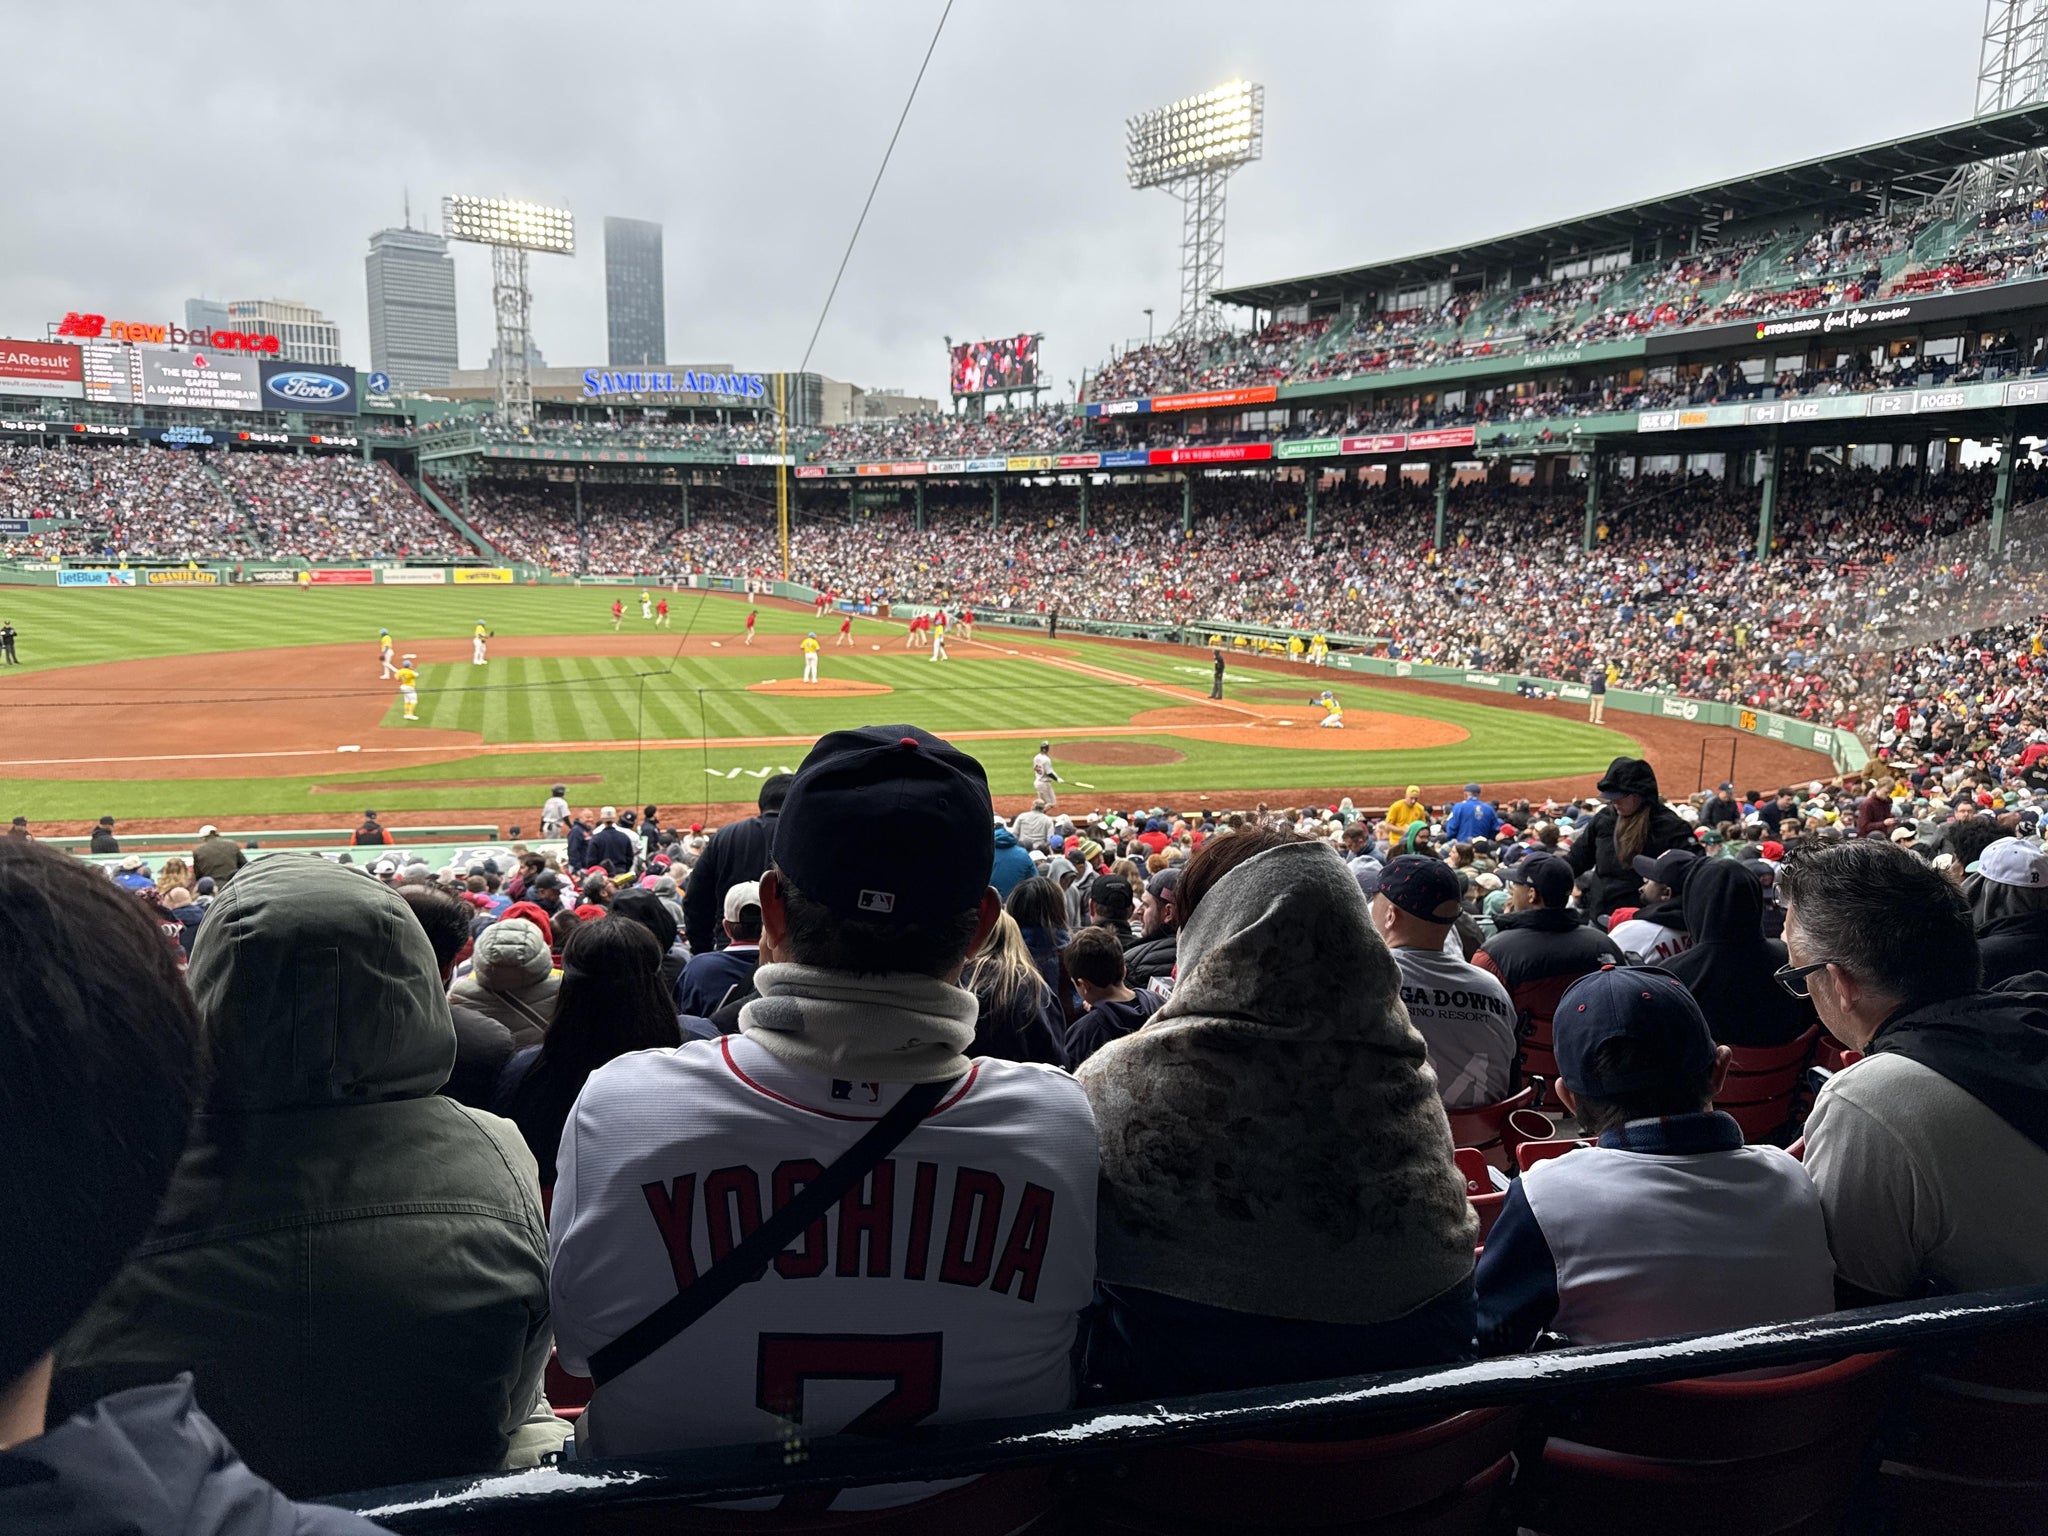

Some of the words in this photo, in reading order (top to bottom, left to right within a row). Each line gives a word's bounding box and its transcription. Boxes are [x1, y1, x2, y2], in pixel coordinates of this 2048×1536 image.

[1849, 309, 1869, 328] the
[110, 320, 166, 344] new
[169, 322, 280, 354] balance
[162, 367, 180, 377] THE
[182, 369, 199, 378] RED
[201, 370, 218, 380] SOX
[147, 385, 156, 394] A
[157, 385, 187, 395] HAPPY
[283, 376, 334, 398] Ford
[583, 368, 679, 397] SAMUEL
[680, 368, 764, 398] ADAMS
[2017, 384, 2039, 400] 0-1
[168, 396, 186, 406] AND
[188, 397, 213, 407] MANY
[1880, 398, 1902, 412] 1-2
[1920, 393, 1965, 408] ROGERS
[1756, 407, 1775, 420] 0-1
[1, 421, 17, 430] Tap
[17, 421, 24, 430] &
[25, 423, 37, 431] go
[1641, 415, 1659, 428] DUE
[1660, 414, 1673, 427] UP
[86, 424, 101, 434] Tap
[101, 425, 108, 433] &
[109, 427, 120, 435] go
[160, 433, 214, 444] ORCHARD
[63, 572, 101, 584] jetBlue
[195, 571, 217, 583] CITY
[1438, 1009, 1490, 1023] RESORT
[642, 1158, 1055, 1303] YOSHIDA
[755, 1331, 943, 1510] 7
